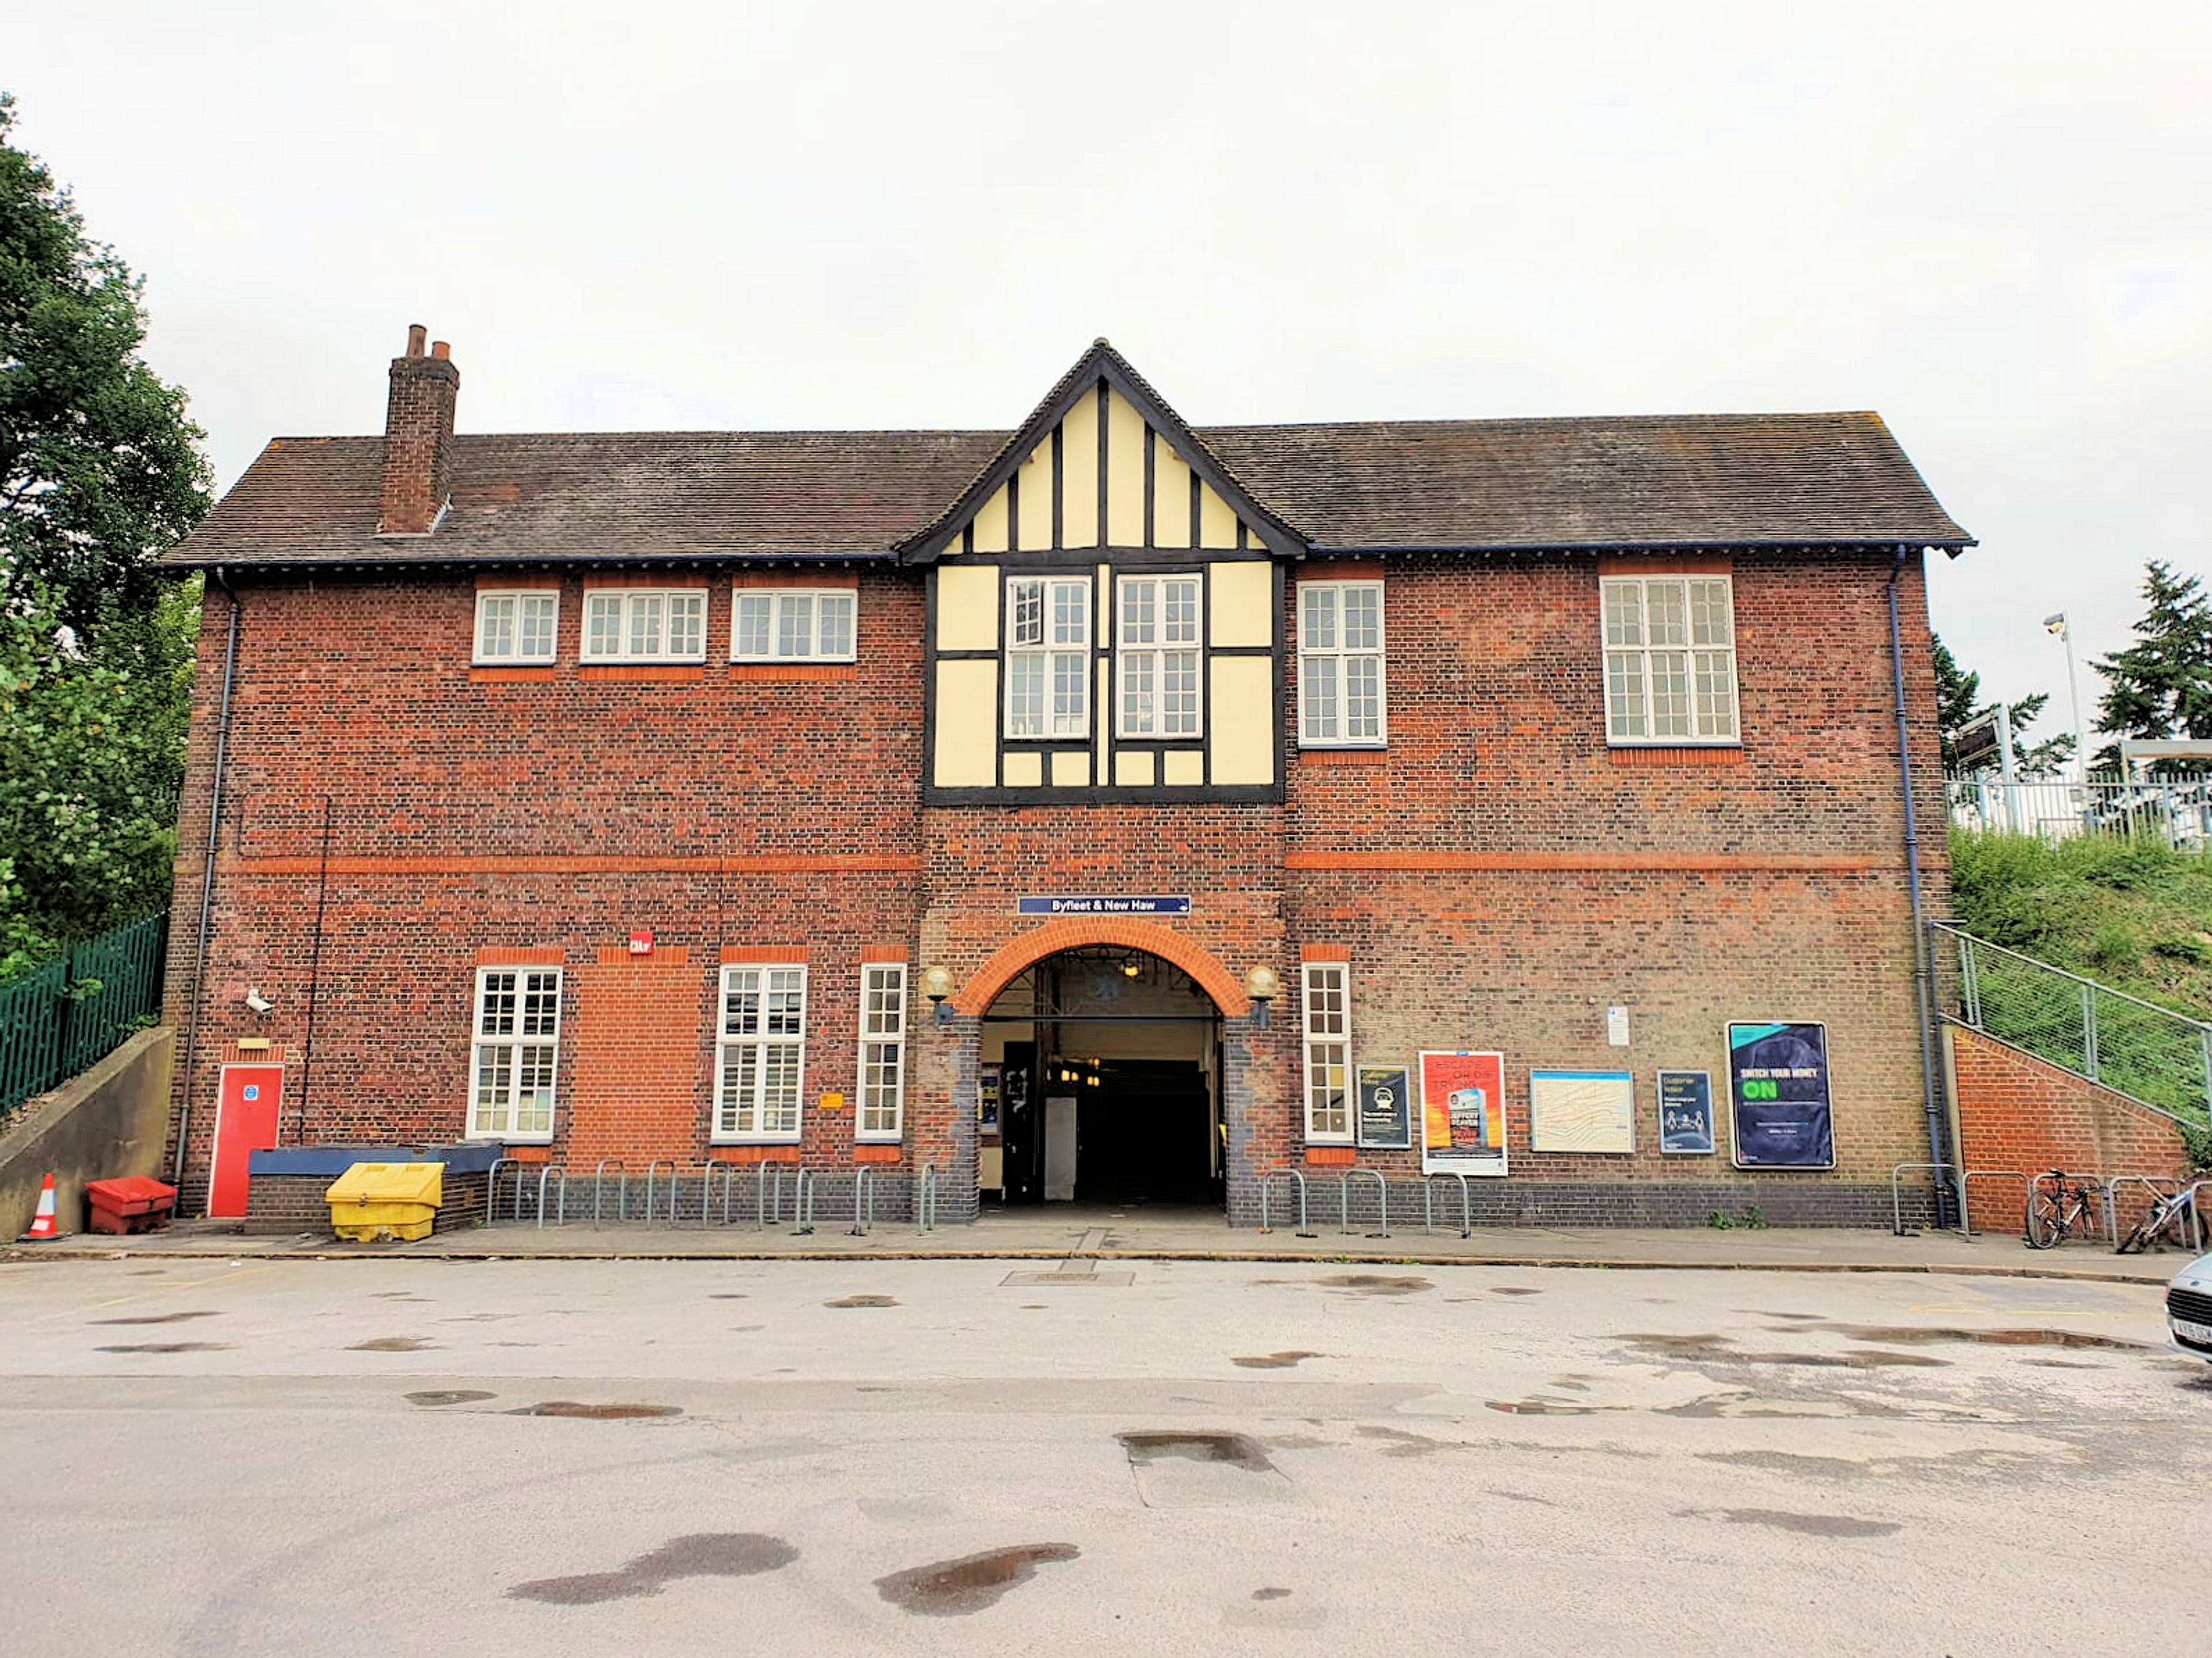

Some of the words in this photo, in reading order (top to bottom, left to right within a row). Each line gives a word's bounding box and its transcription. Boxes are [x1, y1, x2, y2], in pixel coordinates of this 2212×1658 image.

[1052, 900, 1090, 913] Byfleet
[1093, 900, 1102, 910] &
[1105, 900, 1129, 910] New
[1131, 900, 1155, 910] Haw
[1435, 1061, 1484, 1069] ESCAPE
[1740, 1069, 1768, 1078] SWITCH
[1770, 1068, 1790, 1078] YOUR
[1792, 1068, 1817, 1078] MONEY
[1433, 1080, 1476, 1089] TRYING
[1743, 1081, 1778, 1099] ON
